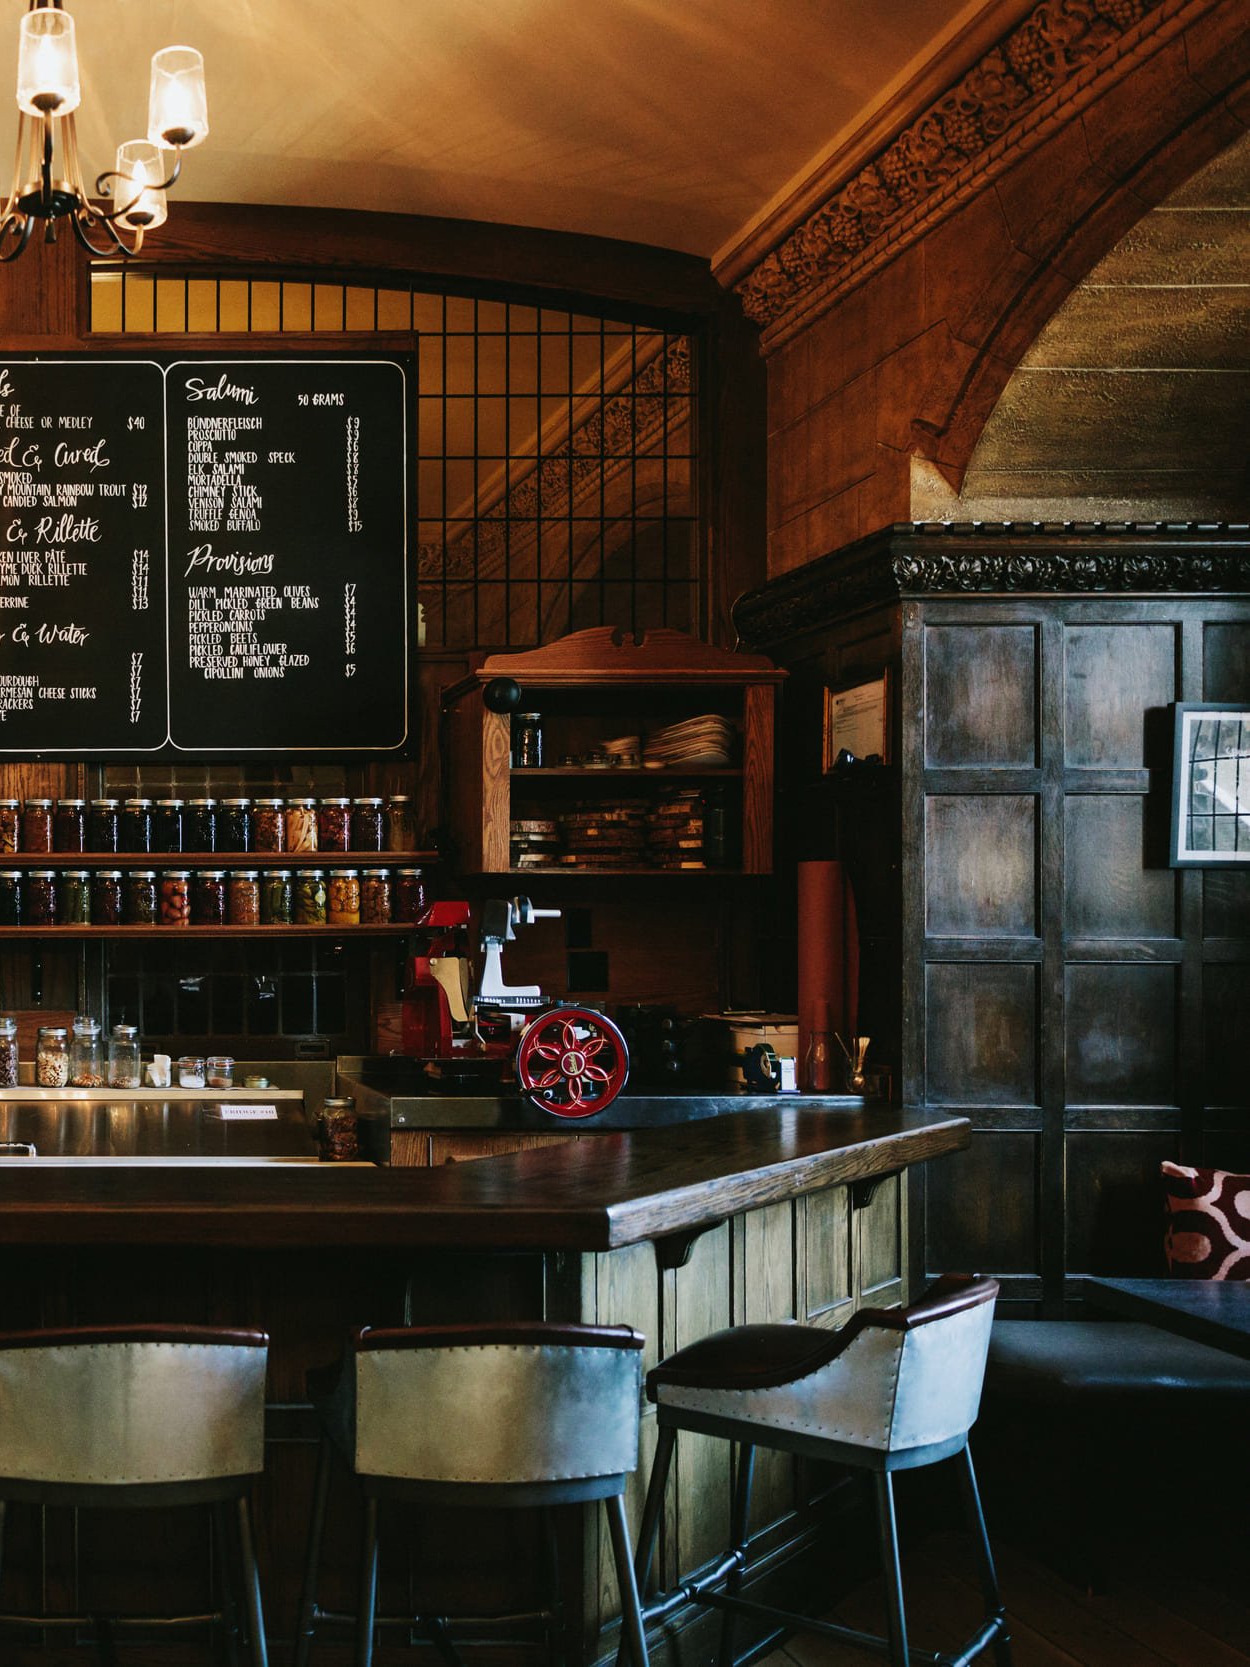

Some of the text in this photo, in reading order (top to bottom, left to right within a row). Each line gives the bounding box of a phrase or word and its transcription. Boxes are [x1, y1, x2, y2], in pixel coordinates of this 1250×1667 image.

[185, 374, 345, 406] Salumi 50 GRAMS
[10, 404, 21, 416] OF
[6, 417, 34, 429] CHEESE
[41, 417, 52, 428] OR
[59, 417, 93, 428] MEDLEY
[127, 416, 144, 431] $40
[188, 429, 236, 441] PROSCIUTTO
[188, 441, 212, 452] COPPA
[55, 439, 110, 473] Cured
[188, 452, 296, 464] DOUBLE SMOKED SPECK
[188, 463, 245, 474] ELK SALAMI
[188, 474, 241, 486] MORTADELLA
[7, 484, 51, 496] MOUNTAIN
[57, 484, 94, 496] RAINBOW
[98, 484, 126, 496] TROUT
[188, 485, 257, 497] CHIMNEY STICK
[3, 496, 37, 507] CANDIED
[43, 496, 77, 507] SALMON
[188, 497, 262, 509] VENISON SALAMI
[189, 508, 256, 520] TRUFFLE GENOA
[34, 513, 102, 543] Rillette
[189, 520, 219, 531] SMOKED
[227, 520, 260, 531] BUFFALO
[17, 551, 40, 563] LIVER
[184, 543, 274, 577] Provisions
[21, 563, 42, 575] DUCK
[49, 563, 88, 576] RILLETTE
[28, 575, 70, 586] RILLETTE
[188, 586, 310, 598] WARM MARINATED OLIVES
[132, 598, 149, 610] $13
[189, 598, 319, 610] DILL PICKLED GREEN BEANS
[189, 609, 266, 621] PICKLED CARROTS
[189, 621, 253, 633] PEPPERONCINIS
[35, 623, 90, 646] Water
[189, 633, 258, 644] PICKLED BEETS
[190, 643, 287, 655] PICKLED CAULIFLOWER
[190, 655, 309, 668] PRESERVED HONEY GLAZED
[204, 664, 356, 679] CIPOLLINI ONIONS $5
[39, 688, 66, 699] CHEESE
[70, 687, 96, 699] STICKS
